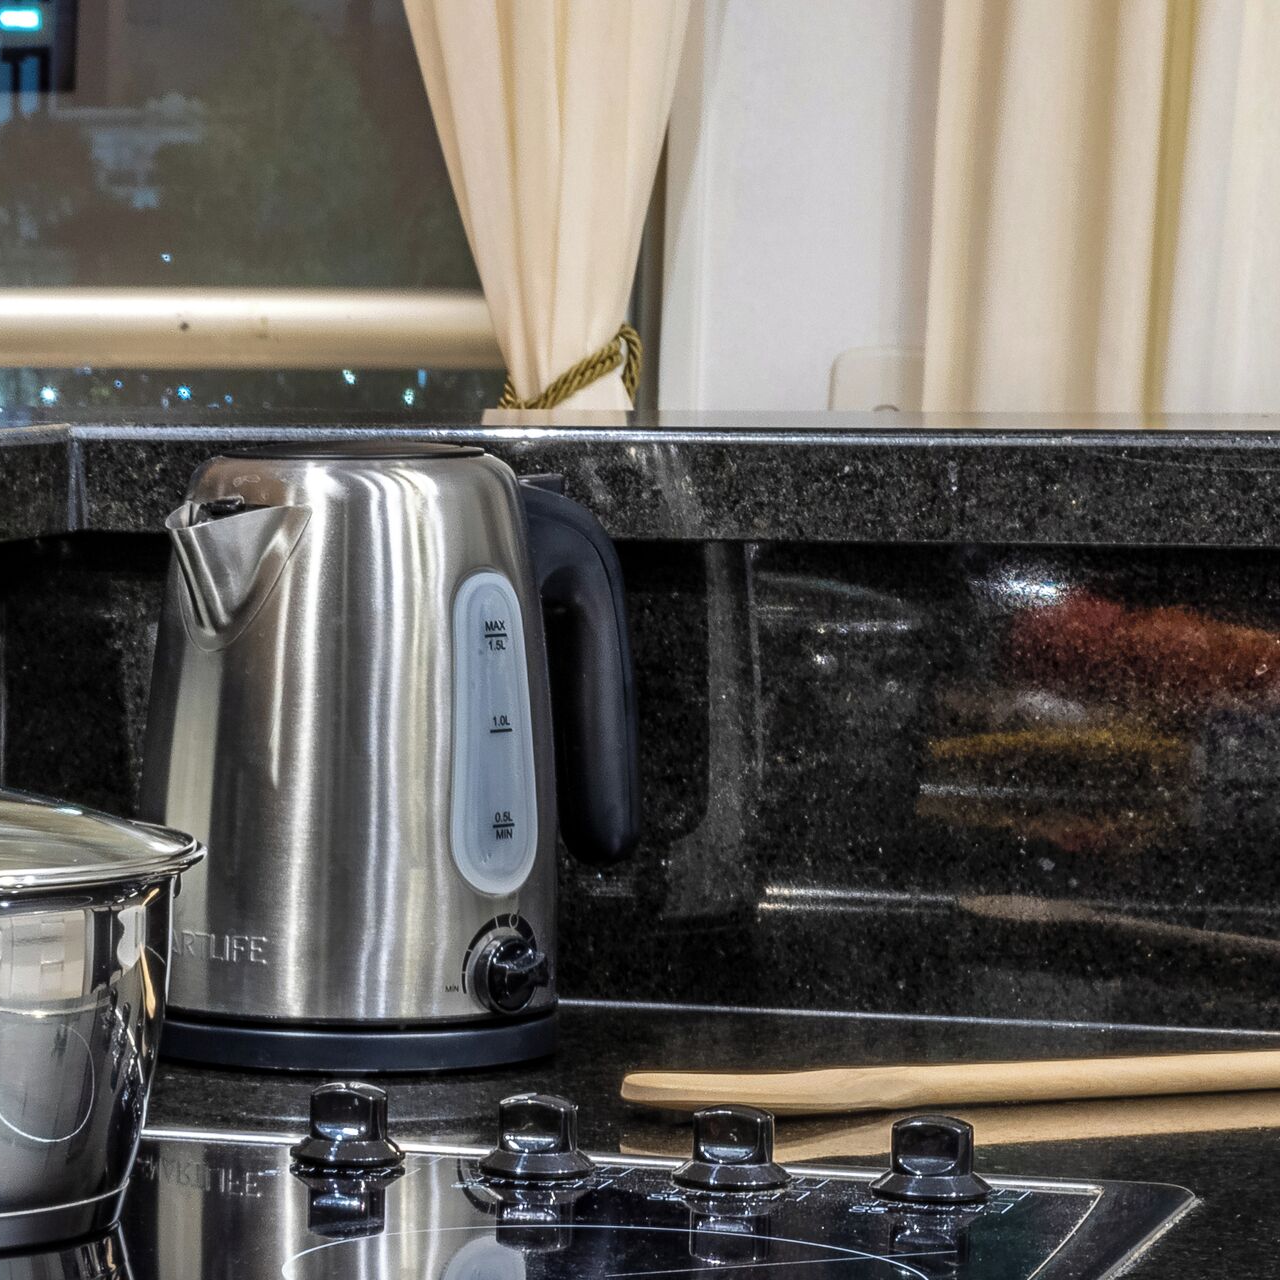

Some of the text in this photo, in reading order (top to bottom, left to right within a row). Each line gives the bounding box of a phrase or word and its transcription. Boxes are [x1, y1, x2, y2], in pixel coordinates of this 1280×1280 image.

[484, 620, 506, 632] MAX
[487, 639, 507, 652] 1.5L
[491, 714, 511, 727] 1.0L
[494, 811, 514, 823] 0.5L
[495, 828, 514, 840] MIN
